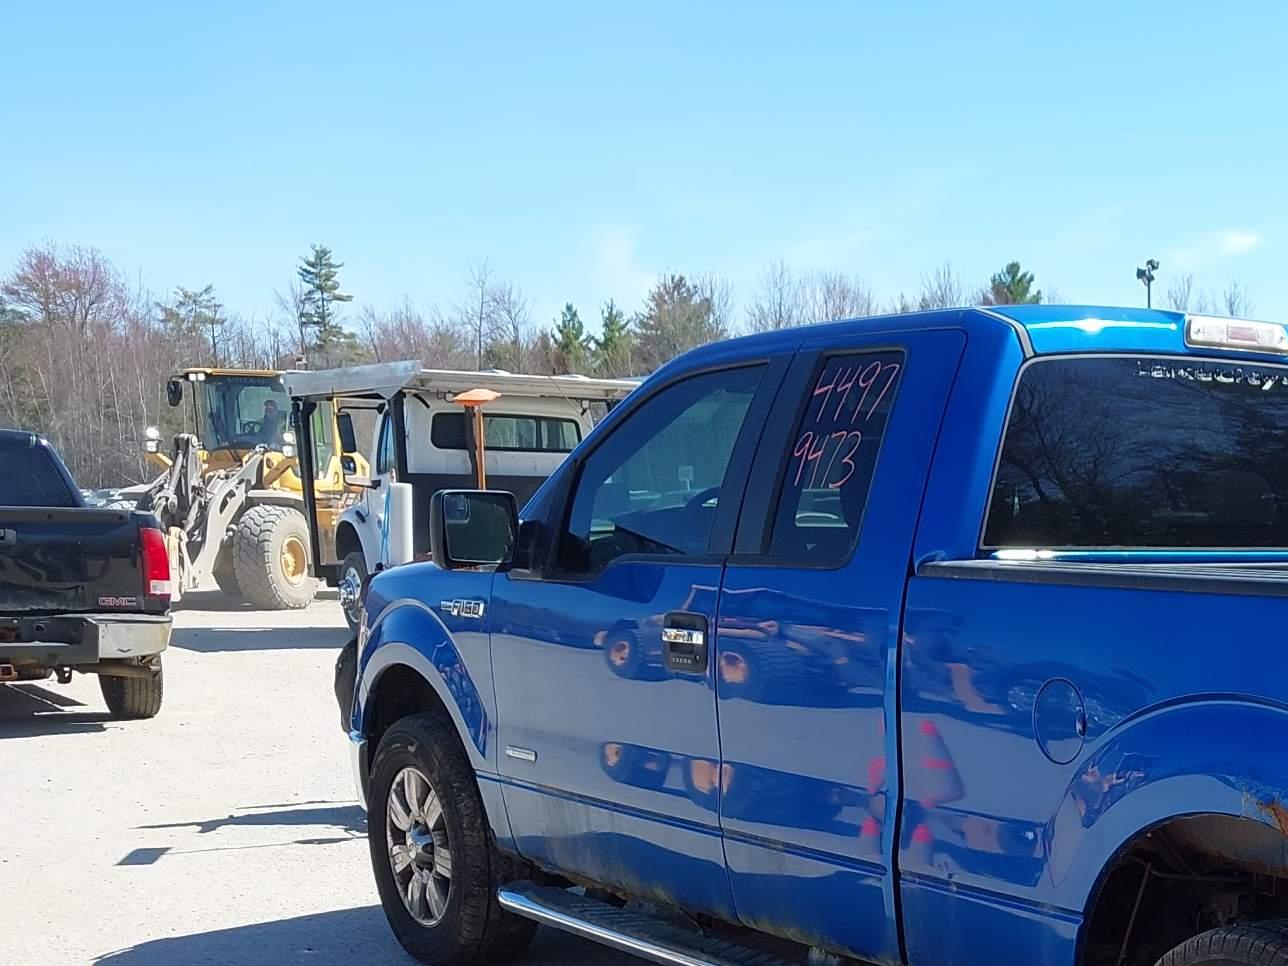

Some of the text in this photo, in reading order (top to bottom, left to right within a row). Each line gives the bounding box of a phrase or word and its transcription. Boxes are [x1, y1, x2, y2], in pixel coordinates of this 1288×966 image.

[813, 361, 900, 424] 4497
[793, 431, 862, 489] 9473
[98, 597, 136, 606] GMC
